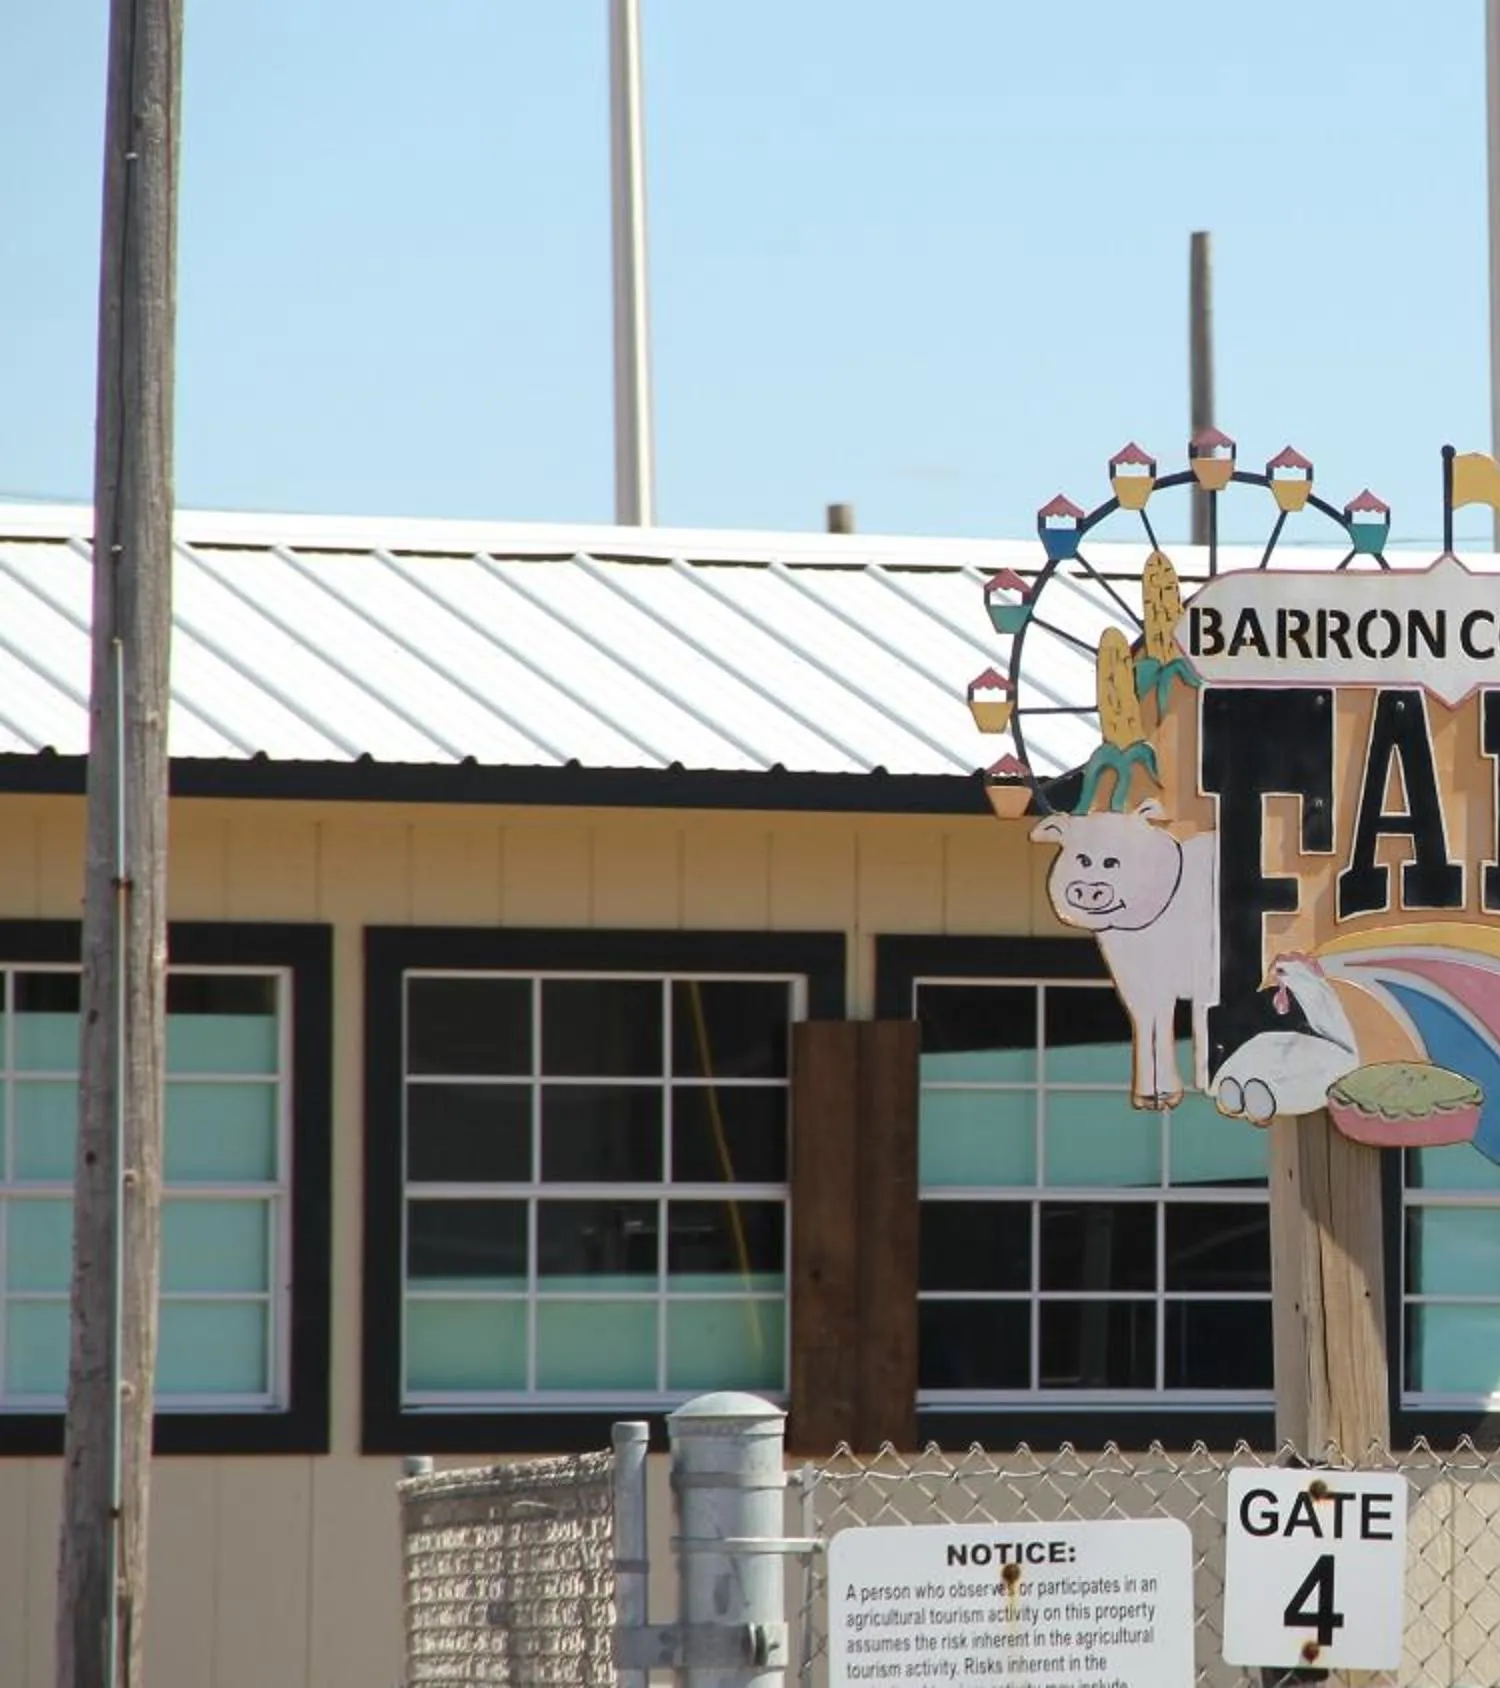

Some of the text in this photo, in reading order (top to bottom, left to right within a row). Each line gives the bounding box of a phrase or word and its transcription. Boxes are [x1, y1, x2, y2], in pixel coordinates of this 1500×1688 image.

[1189, 607, 1446, 660] BARRON
[1239, 1488, 1393, 1541] GATE
[947, 1541, 1076, 1566] NOTICE:
[846, 1575, 1157, 1604] A person who observes or participates in an
[1283, 1554, 1344, 1646] 4
[846, 1602, 1155, 1631] agricultural tourism activity on this property
[847, 1626, 1155, 1653] assumes the risk inherent in the agricultural
[847, 1661, 901, 1679] tourism
[964, 1656, 1002, 1675] Risks
[1007, 1655, 1065, 1673] inherent
[1070, 1653, 1081, 1671] in
[1085, 1653, 1107, 1671] the
